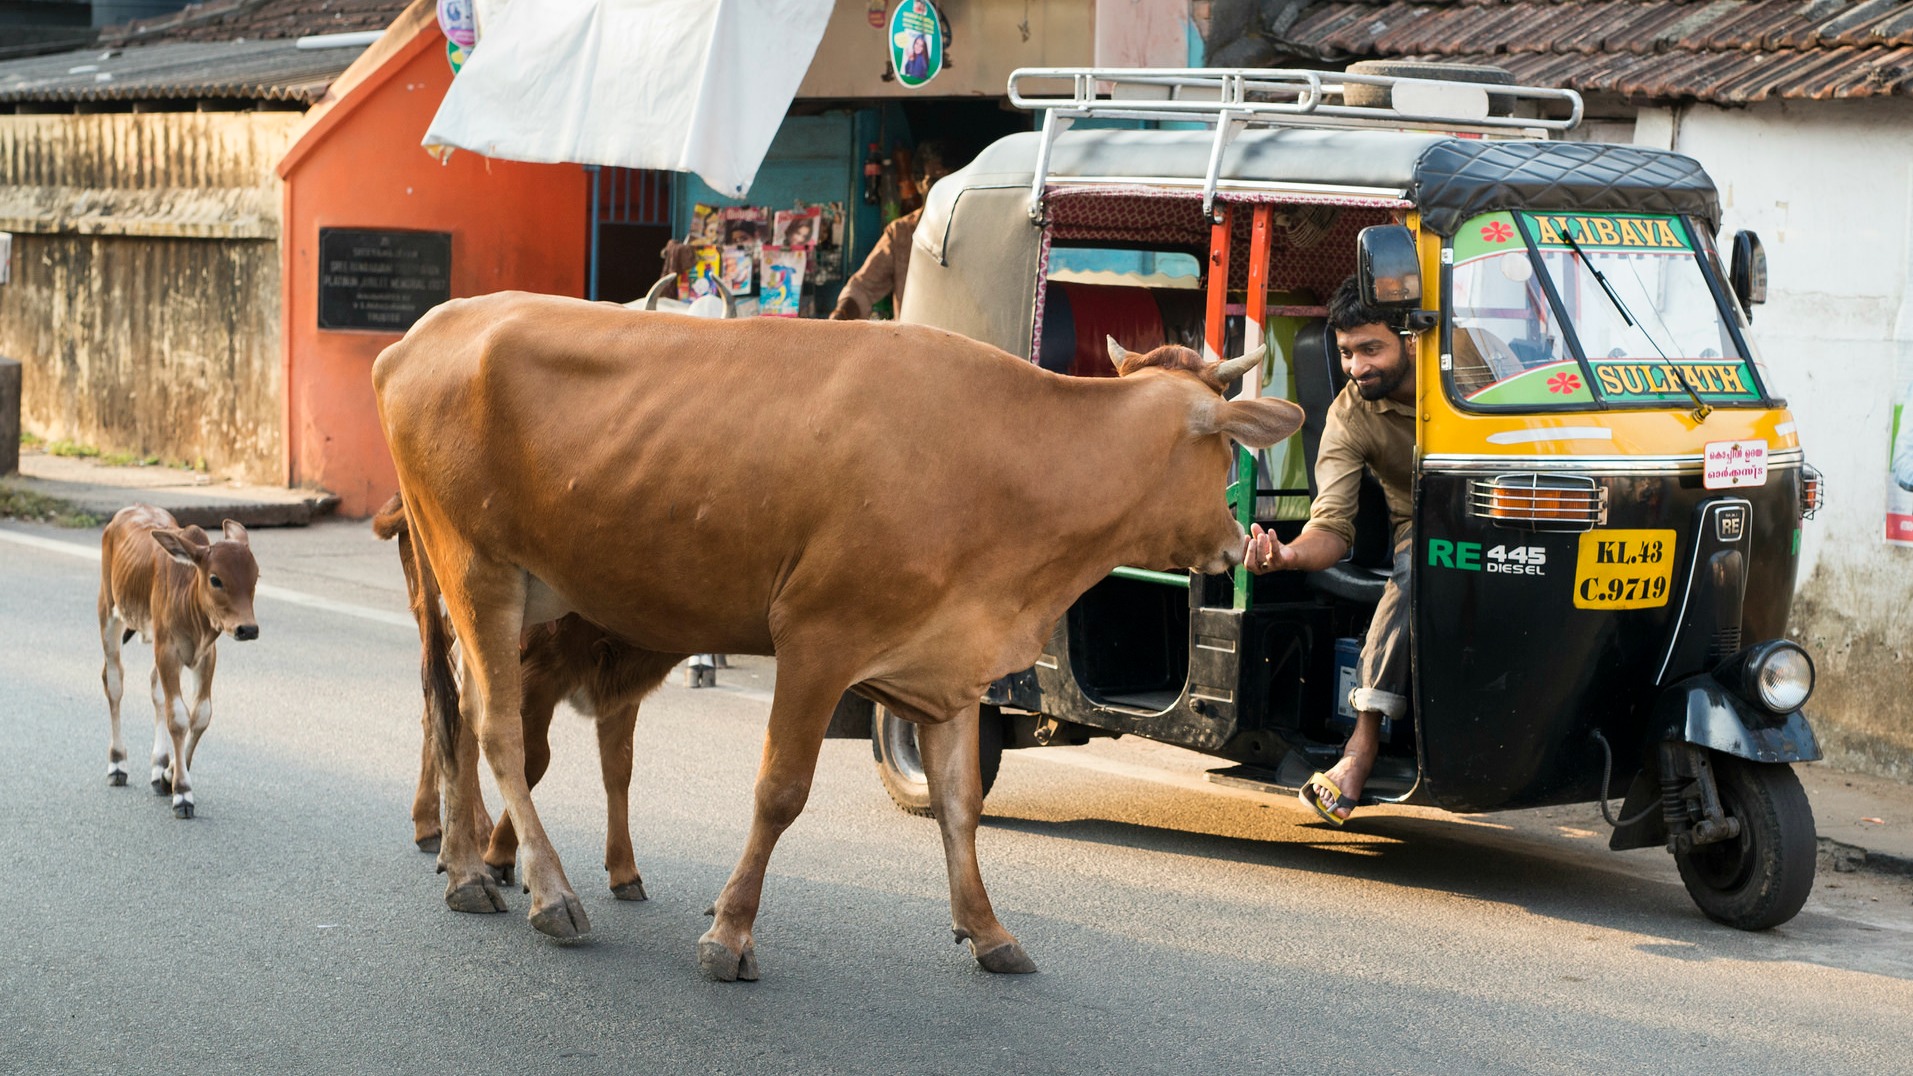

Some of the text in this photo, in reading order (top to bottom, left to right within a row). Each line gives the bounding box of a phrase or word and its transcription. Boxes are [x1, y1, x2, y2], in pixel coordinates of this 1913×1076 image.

[1597, 365, 1748, 394] SULFATH
[1722, 518, 1740, 535] RE
[1428, 538, 1546, 571] RE 445
[1596, 541, 1663, 564] KL.43
[1487, 562, 1545, 575] DIESEL
[1580, 576, 1666, 601] C.9719
